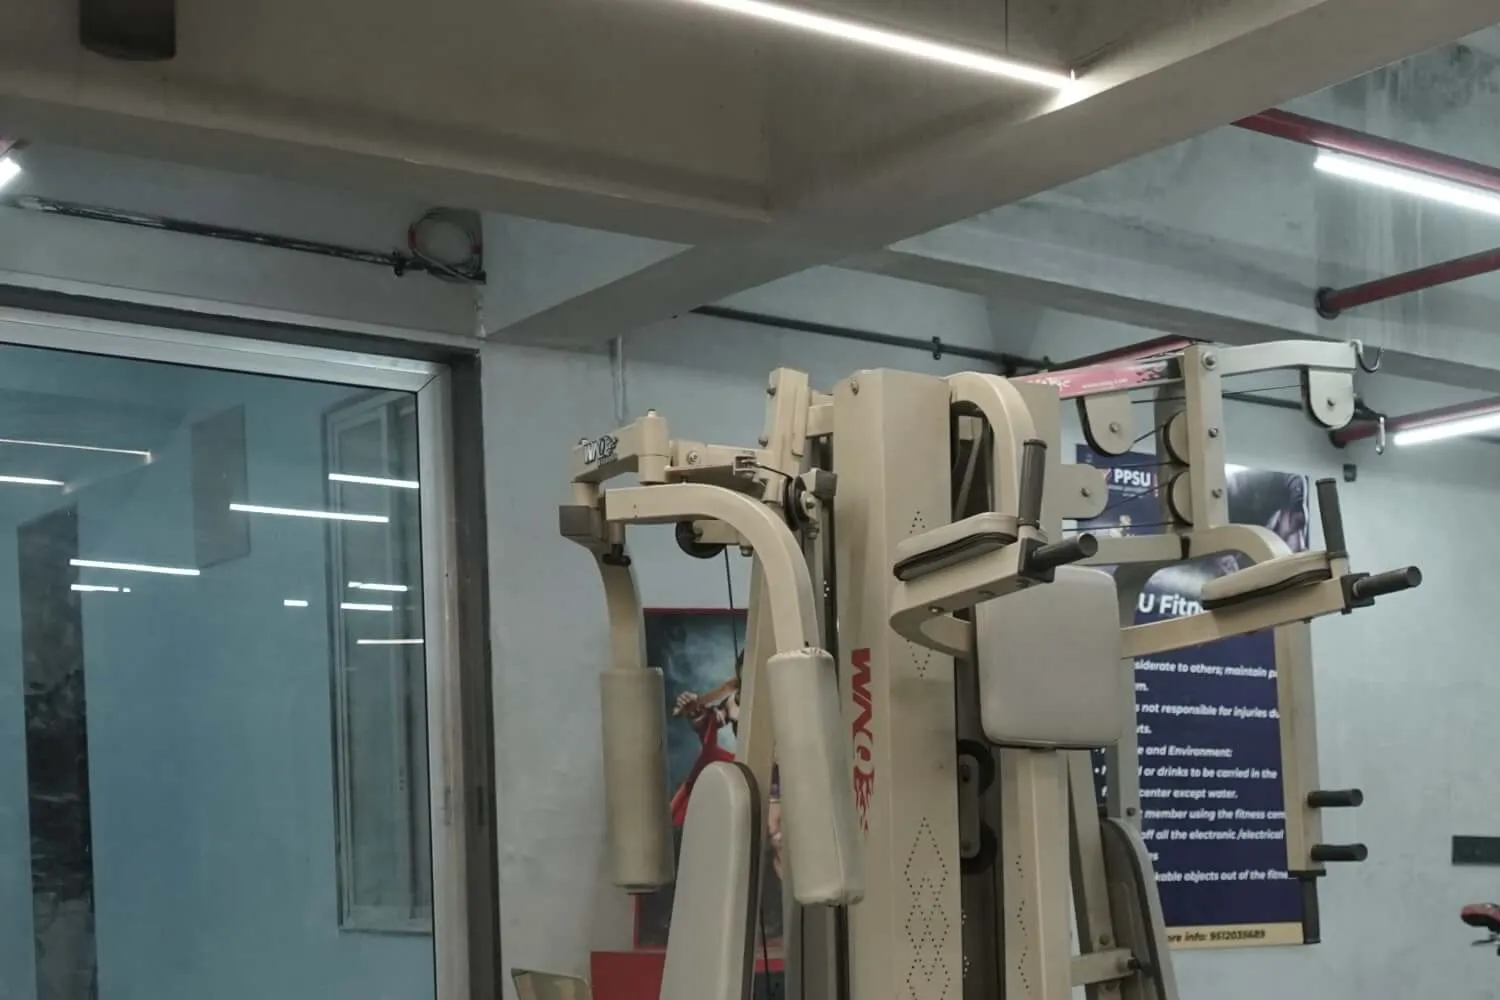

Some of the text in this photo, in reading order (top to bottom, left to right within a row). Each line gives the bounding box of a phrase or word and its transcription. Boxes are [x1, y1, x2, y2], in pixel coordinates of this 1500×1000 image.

[1113, 467, 1151, 488] PPSU
[1159, 592, 1207, 616] Fitn
[1135, 659, 1176, 672] siderate
[1177, 662, 1189, 673] to
[1224, 665, 1267, 678] maintain
[1141, 703, 1160, 714] not
[1161, 704, 1217, 717] responsible
[1218, 706, 1233, 717] for
[1233, 707, 1268, 719] injuries
[1145, 745, 1167, 756] and
[1168, 745, 1233, 758] Environment:
[1144, 768, 1156, 777] or
[1157, 766, 1188, 778] drinks
[1190, 767, 1201, 778] to
[1202, 768, 1215, 778] be
[1216, 768, 1250, 779] carried
[1250, 768, 1260, 779] in
[1261, 768, 1278, 779] the
[1139, 788, 1239, 800] center except water.
[1144, 808, 1187, 820] member
[1188, 809, 1216, 822] using
[1217, 808, 1234, 820] the
[1235, 808, 1266, 820] fitness
[1156, 829, 1169, 840] all
[1170, 829, 1188, 840] the
[1189, 829, 1237, 841] electronic
[1155, 870, 1182, 882] kable
[1184, 870, 1219, 884] objects
[1220, 870, 1236, 881] out
[1237, 870, 1249, 880] of
[1250, 869, 1266, 881] the
[1184, 931, 1207, 942] info:
